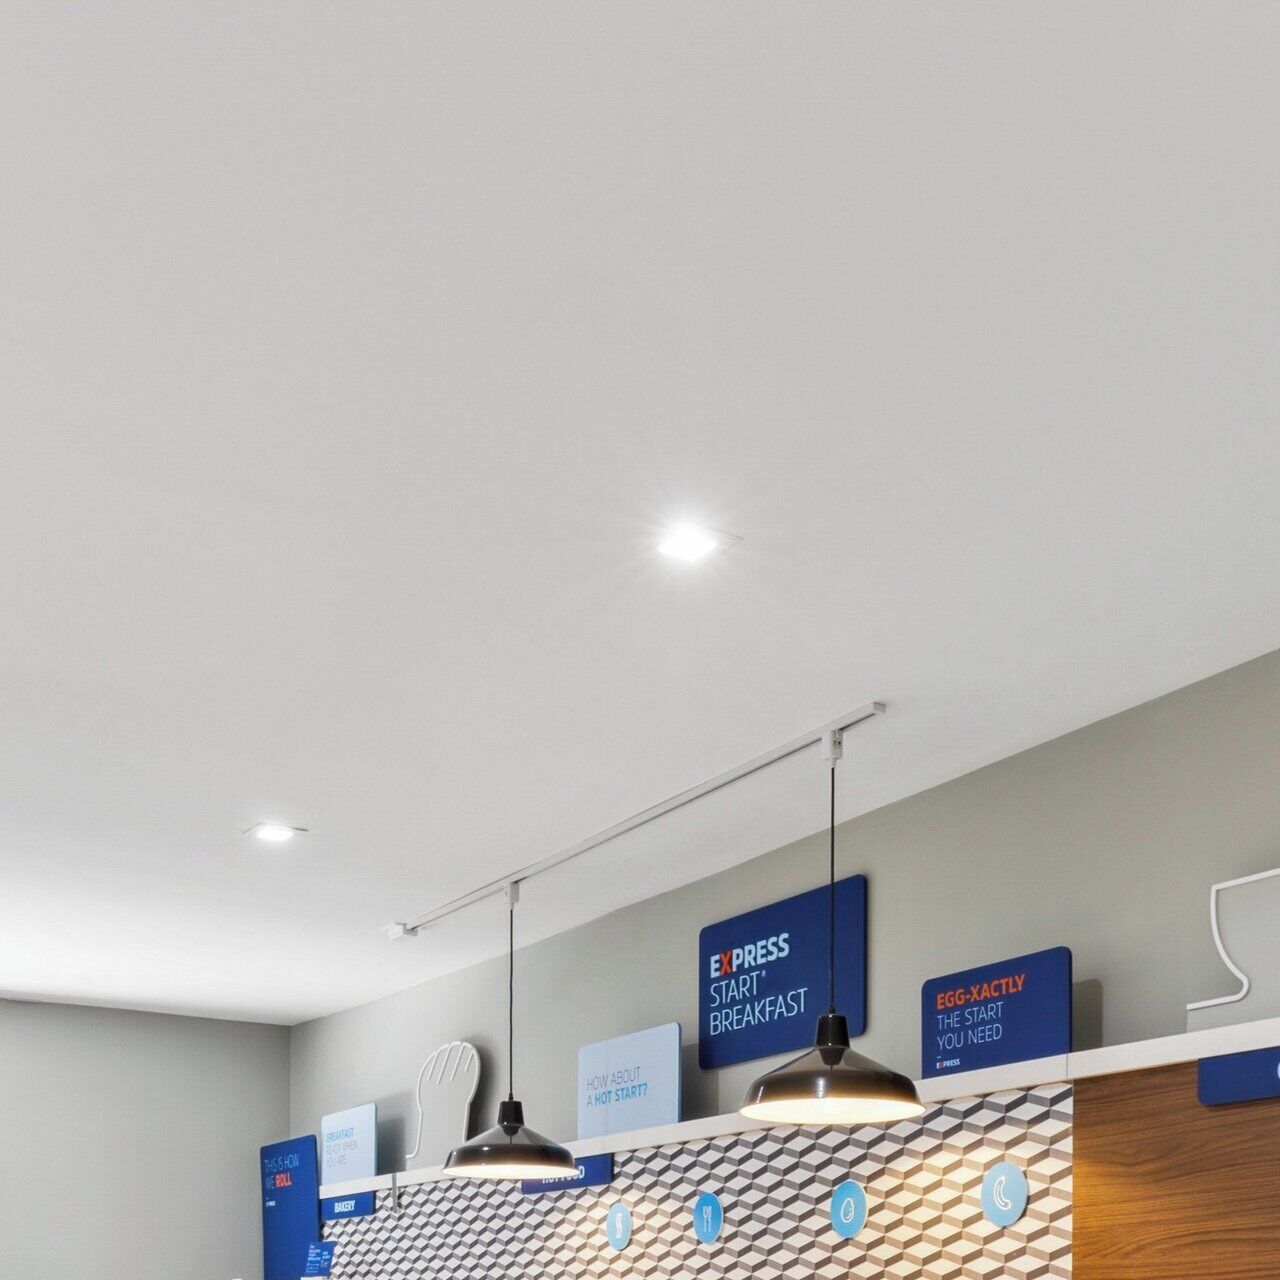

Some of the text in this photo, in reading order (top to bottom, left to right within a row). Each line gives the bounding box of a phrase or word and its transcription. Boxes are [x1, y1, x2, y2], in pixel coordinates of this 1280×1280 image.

[710, 932, 790, 979] EXPRESS
[936, 973, 1025, 1011] EGG-XACTLY
[710, 987, 808, 1036] BREAKFAST
[936, 1001, 1004, 1031] THE START
[936, 1023, 1003, 1051] YOU NEED
[586, 1066, 640, 1091] HOW ABOUT
[587, 1083, 648, 1107] A HOT START?
[284, 1153, 299, 1169] HOW
[275, 1172, 292, 1188] ROLL
[334, 1199, 356, 1213] BAKERY
